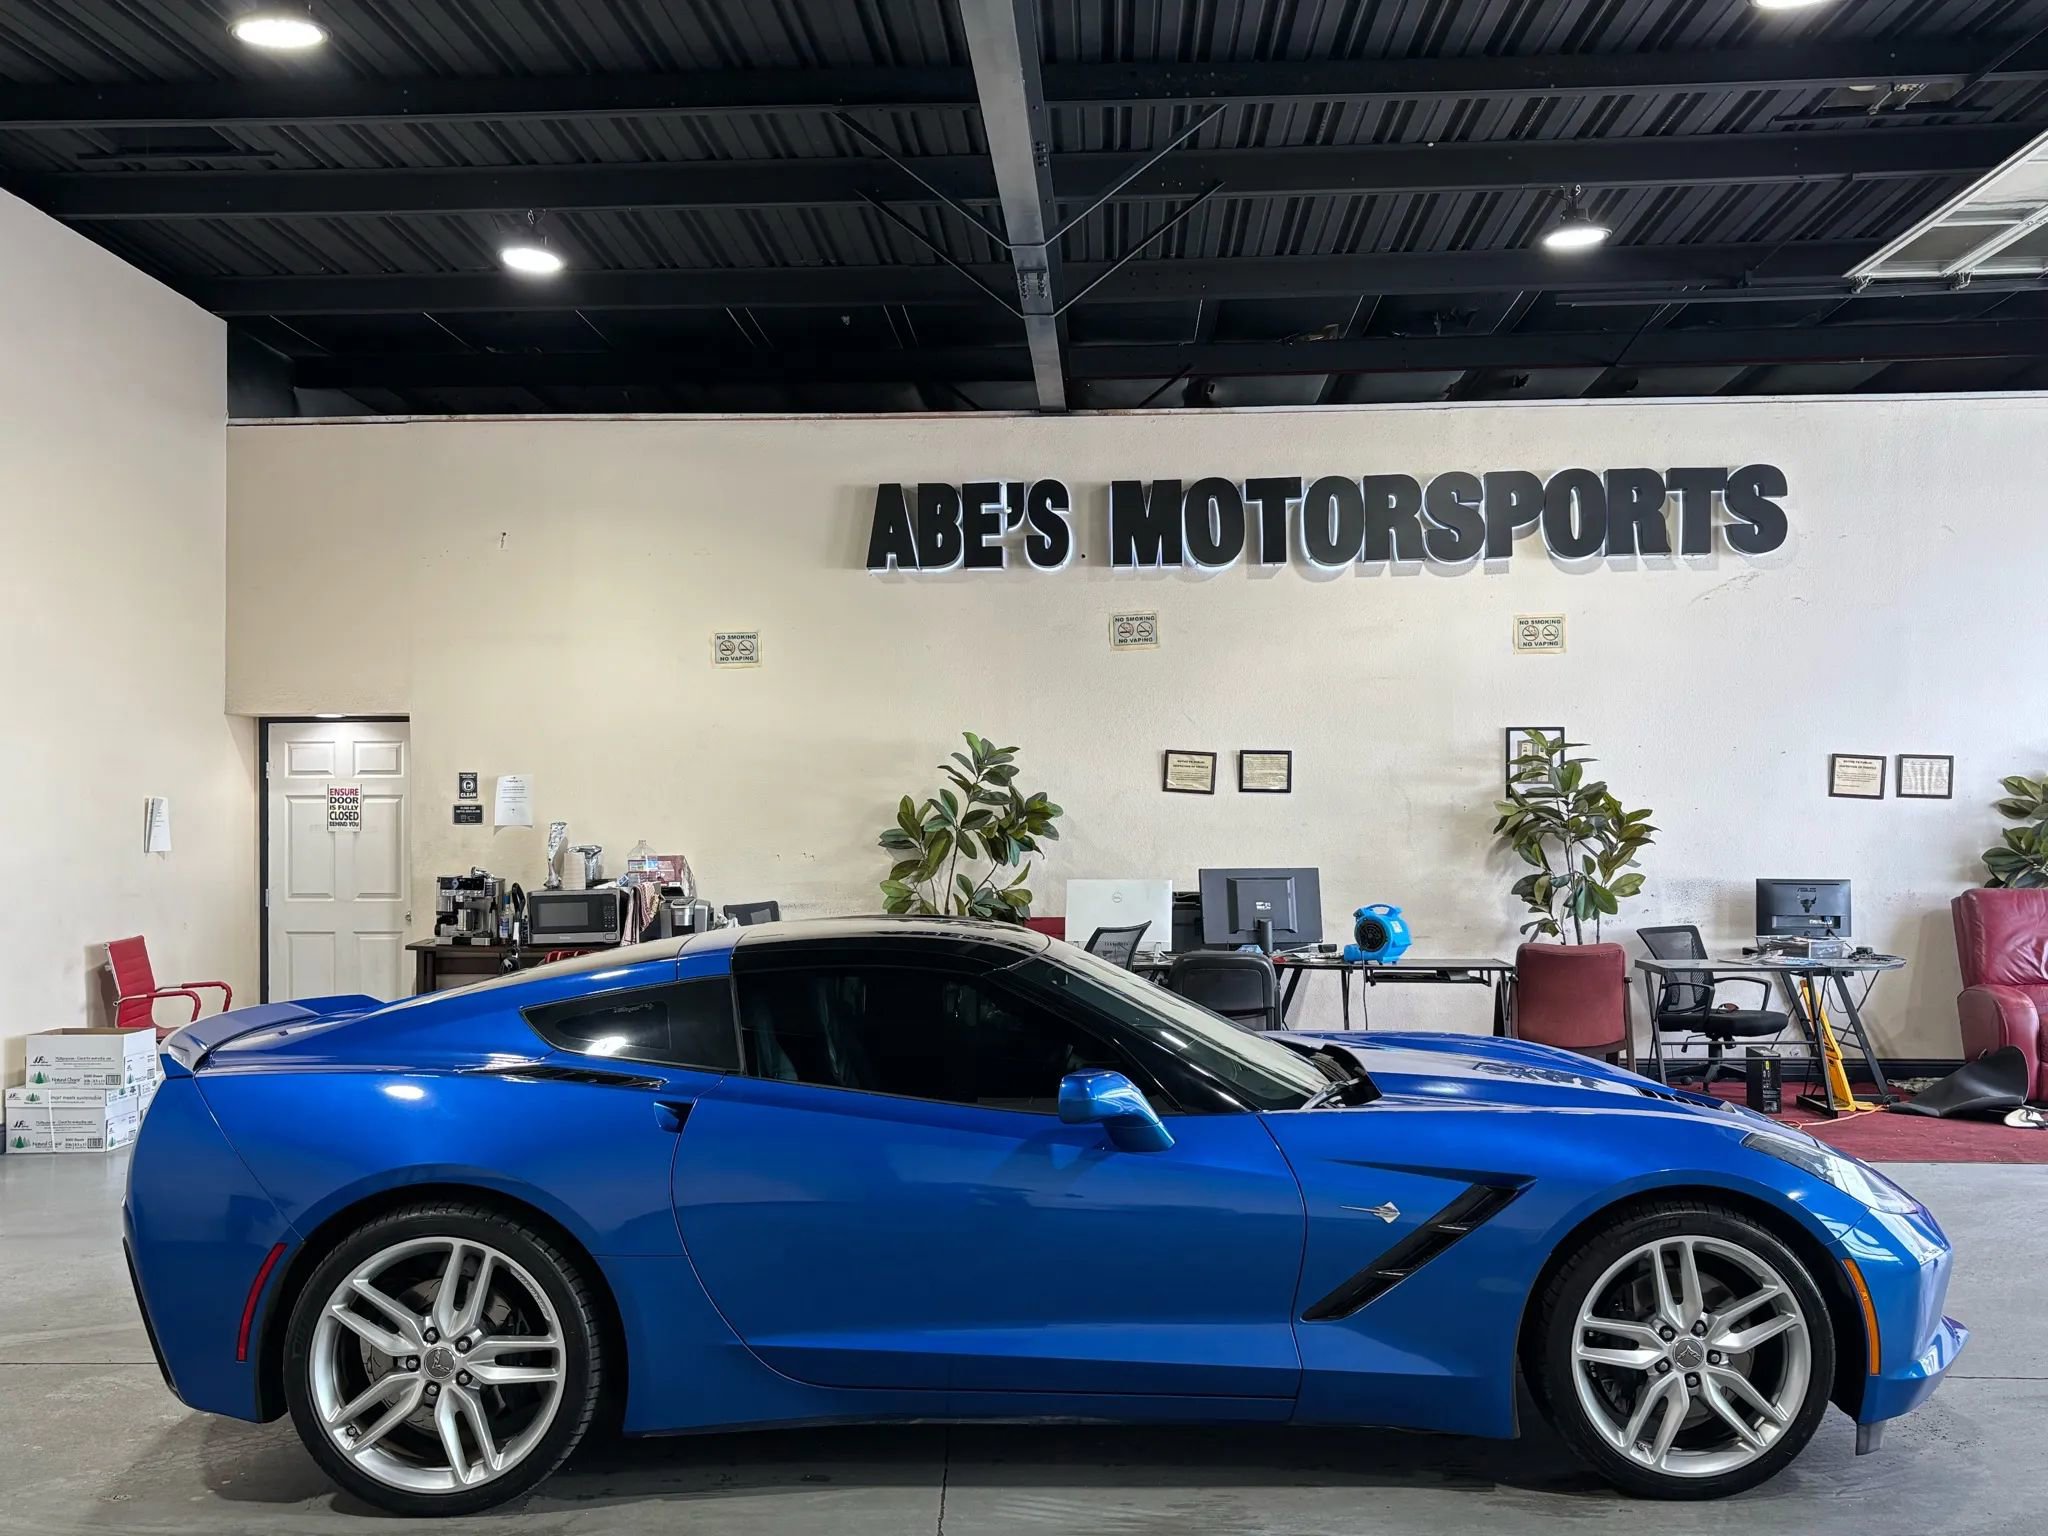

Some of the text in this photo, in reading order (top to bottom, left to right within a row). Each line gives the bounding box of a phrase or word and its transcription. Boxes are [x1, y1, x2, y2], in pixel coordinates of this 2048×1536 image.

[867, 463, 1789, 567] ABE'S MOTORSPORTS
[329, 788, 359, 796] ENSURE
[329, 796, 359, 804] DOOR
[330, 811, 359, 820] CLOSED
